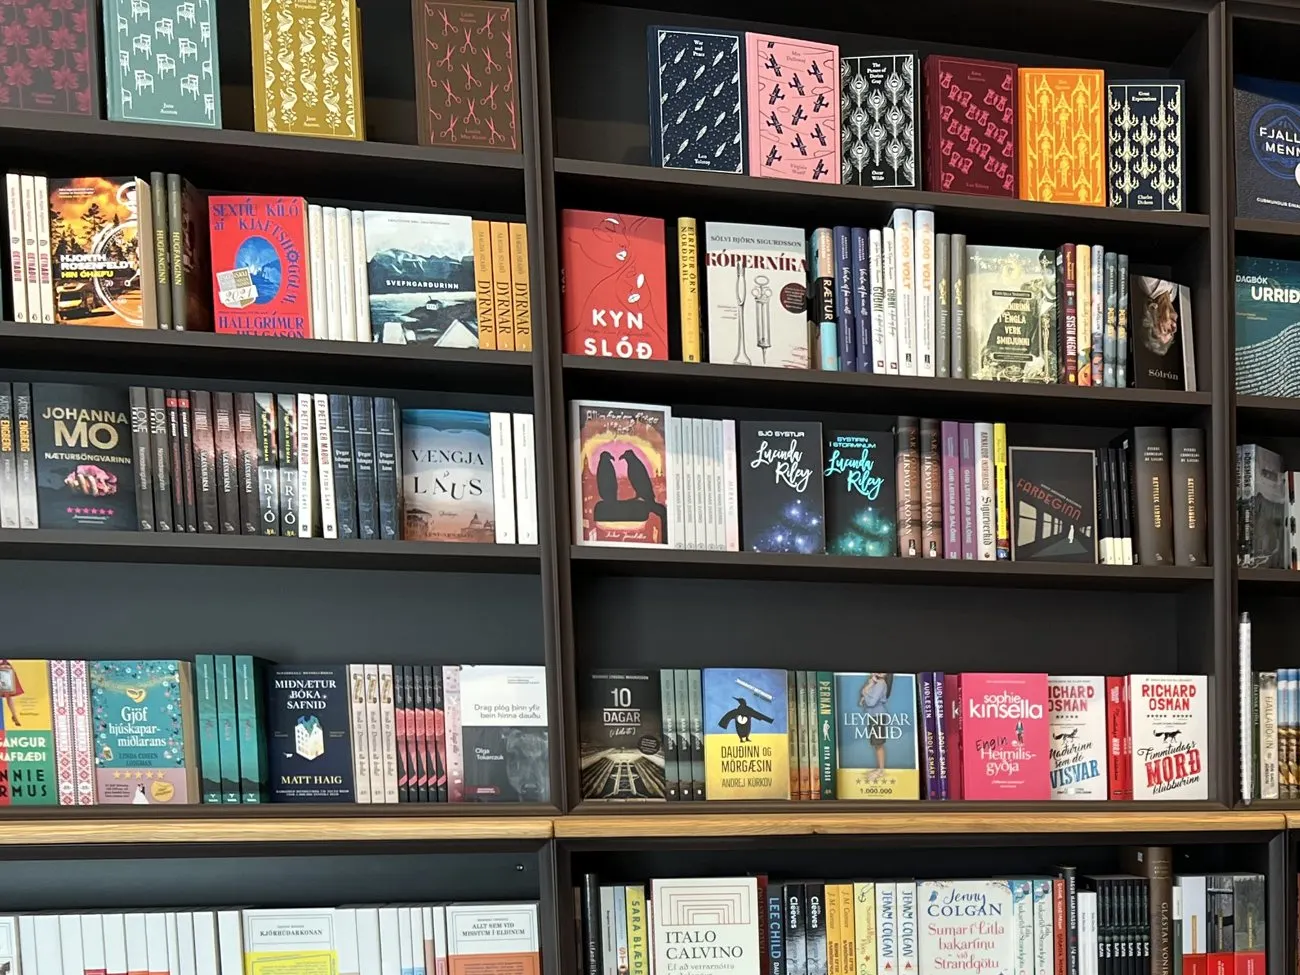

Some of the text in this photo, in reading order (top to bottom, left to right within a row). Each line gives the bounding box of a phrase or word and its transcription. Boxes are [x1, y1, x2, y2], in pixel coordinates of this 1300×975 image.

[212, 198, 299, 217] SEXTÍU KÍLÓ
[710, 235, 730, 243] SÖLVI
[732, 236, 755, 244] BJÖRN
[680, 226, 688, 283] NORÐDAHL
[687, 226, 695, 271] EIRÍKUR
[60, 254, 108, 264] HJORTH
[156, 229, 168, 284] HUGFANGINN
[706, 249, 809, 272] KÓPERNÍKA
[60, 262, 136, 272] ROSENFELDT
[1236, 275, 1268, 285] DAGBÓK
[823, 279, 833, 320] RÆTUR
[478, 279, 491, 336] DYRNAR
[497, 280, 509, 336] DYRNAR
[218, 312, 304, 329] HALLGRÍMUR
[592, 308, 643, 330] KYN
[584, 336, 653, 360] SLÓÐ
[1148, 368, 1179, 381] Sólrún
[43, 406, 128, 424] JOHANNA
[53, 421, 118, 450] MO
[44, 452, 131, 464] NÆTURSÖNGVARINN
[412, 450, 484, 465] VÆNGJA
[751, 439, 802, 468] Lucinda
[824, 449, 874, 476] Lucinda
[775, 462, 812, 493] Riley
[847, 471, 885, 500] Riley
[275, 679, 336, 689] MIÐNÆTUR
[1142, 684, 1196, 698] RICHARD
[290, 689, 321, 699] BÓKA
[611, 688, 631, 707] 10
[819, 681, 832, 716] ÞERNAN
[984, 691, 1021, 704] sophie
[286, 700, 327, 710] SAFNIÐ
[969, 699, 1043, 719] kinsella
[1149, 698, 1190, 711] OSMAN
[121, 707, 148, 725] Gjöf
[603, 711, 640, 723] DAGAR
[844, 713, 911, 726] LEYNDAR
[109, 724, 161, 736] hjúskapar-
[855, 724, 903, 739] MÁLIÐ
[118, 737, 167, 747] miðlarans
[976, 736, 1008, 751] Engin
[721, 746, 772, 758] DAUÐINN OG
[981, 749, 1036, 761] Heimilis-
[1137, 741, 1197, 761] Fimmtudags
[721, 759, 772, 773] MÖRGÆSIN
[986, 760, 1019, 776] gyðja
[1145, 748, 1202, 788] MORÐ
[281, 776, 343, 785] MATT HAIG
[722, 777, 745, 788] ANDREJ
[944, 888, 986, 905] Jenny
[631, 900, 641, 932] SARA
[927, 904, 1002, 917] COLGAN
[769, 897, 781, 959] LEE CHILD
[928, 923, 967, 937] Sumar
[665, 931, 717, 944] ITALO
[666, 946, 743, 960] CALVINO
[934, 957, 1000, 972] Strandgötu
